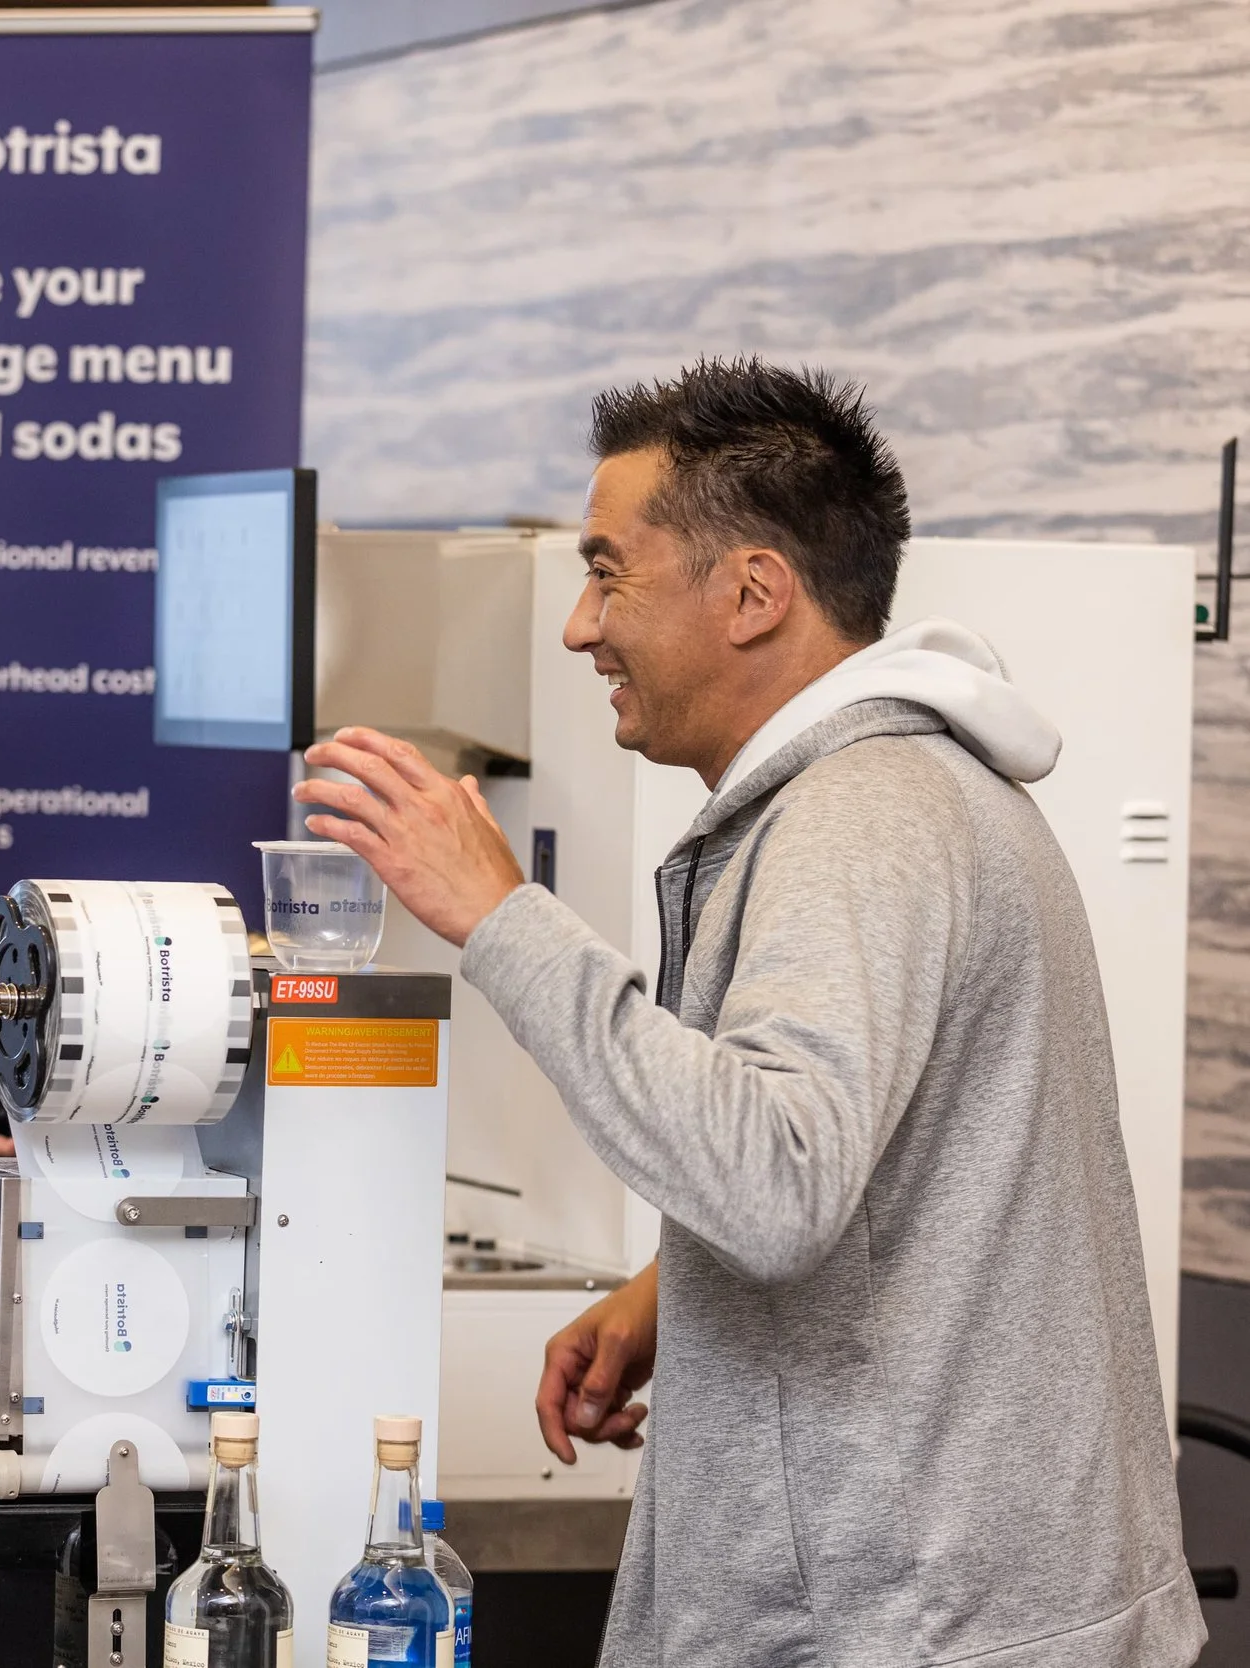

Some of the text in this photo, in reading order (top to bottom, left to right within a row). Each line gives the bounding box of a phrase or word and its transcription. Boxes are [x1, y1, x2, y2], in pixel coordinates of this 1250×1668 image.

[12, 267, 144, 318] your
[69, 346, 232, 384] menu
[12, 411, 183, 461] sodas
[77, 545, 159, 572] reven
[91, 666, 157, 695] cost
[159, 949, 173, 1002] Botrista
[276, 980, 335, 999] ET-99SU
[306, 1026, 432, 1037] WARNING/AVERTISSEMENT
